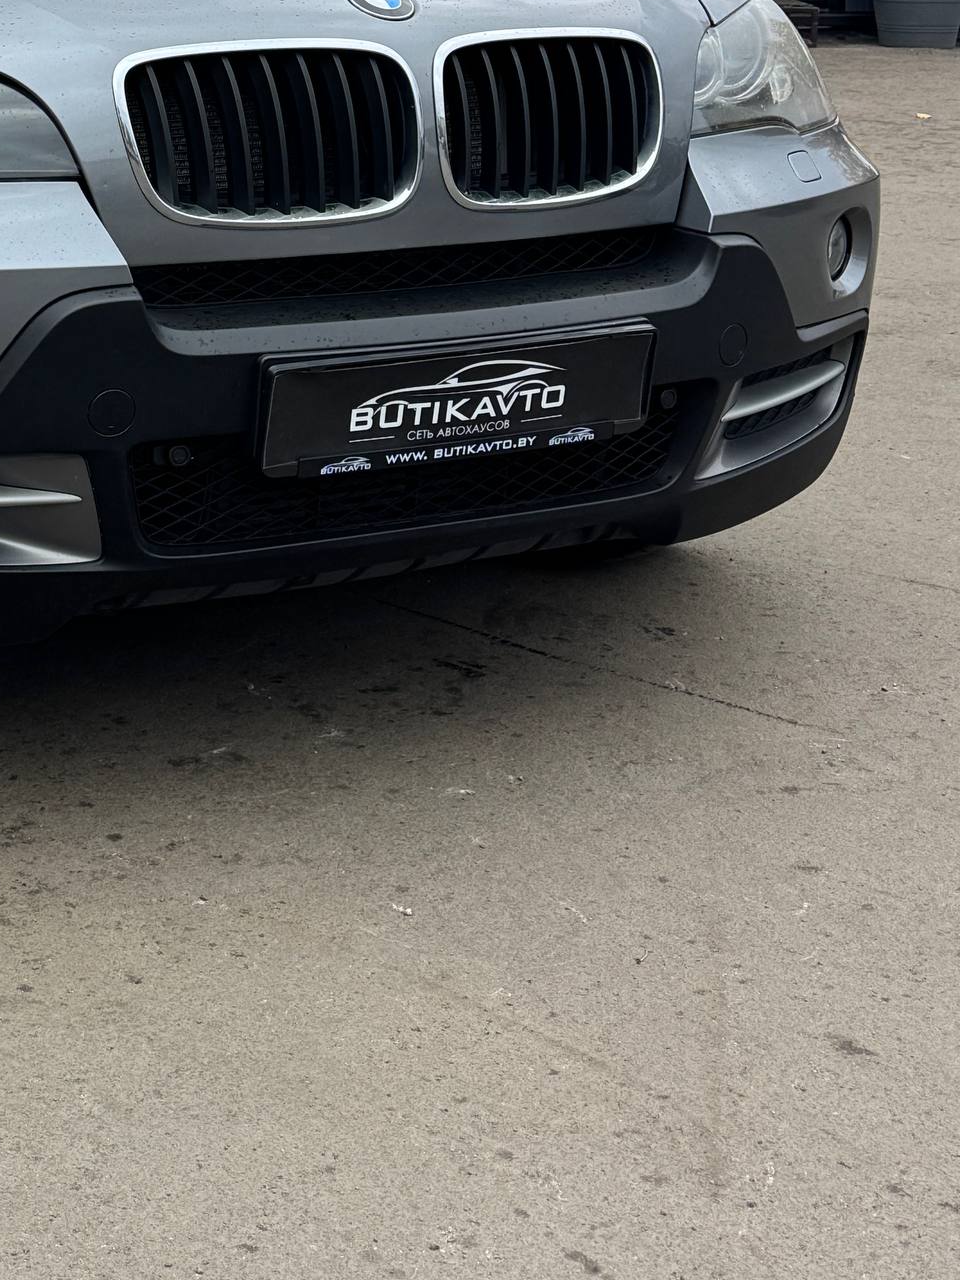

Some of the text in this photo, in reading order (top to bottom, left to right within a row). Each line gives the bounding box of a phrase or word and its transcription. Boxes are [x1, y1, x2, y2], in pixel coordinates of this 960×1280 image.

[349, 384, 566, 432] BUTIKAVTO
[407, 419, 510, 441] СЕТЬ АВТОХАУСОВ
[549, 432, 595, 446] BUTIKAVTO
[386, 435, 537, 465] WWW. BUTIKAVTO.BY
[320, 462, 371, 475] BUTIKAVTO
